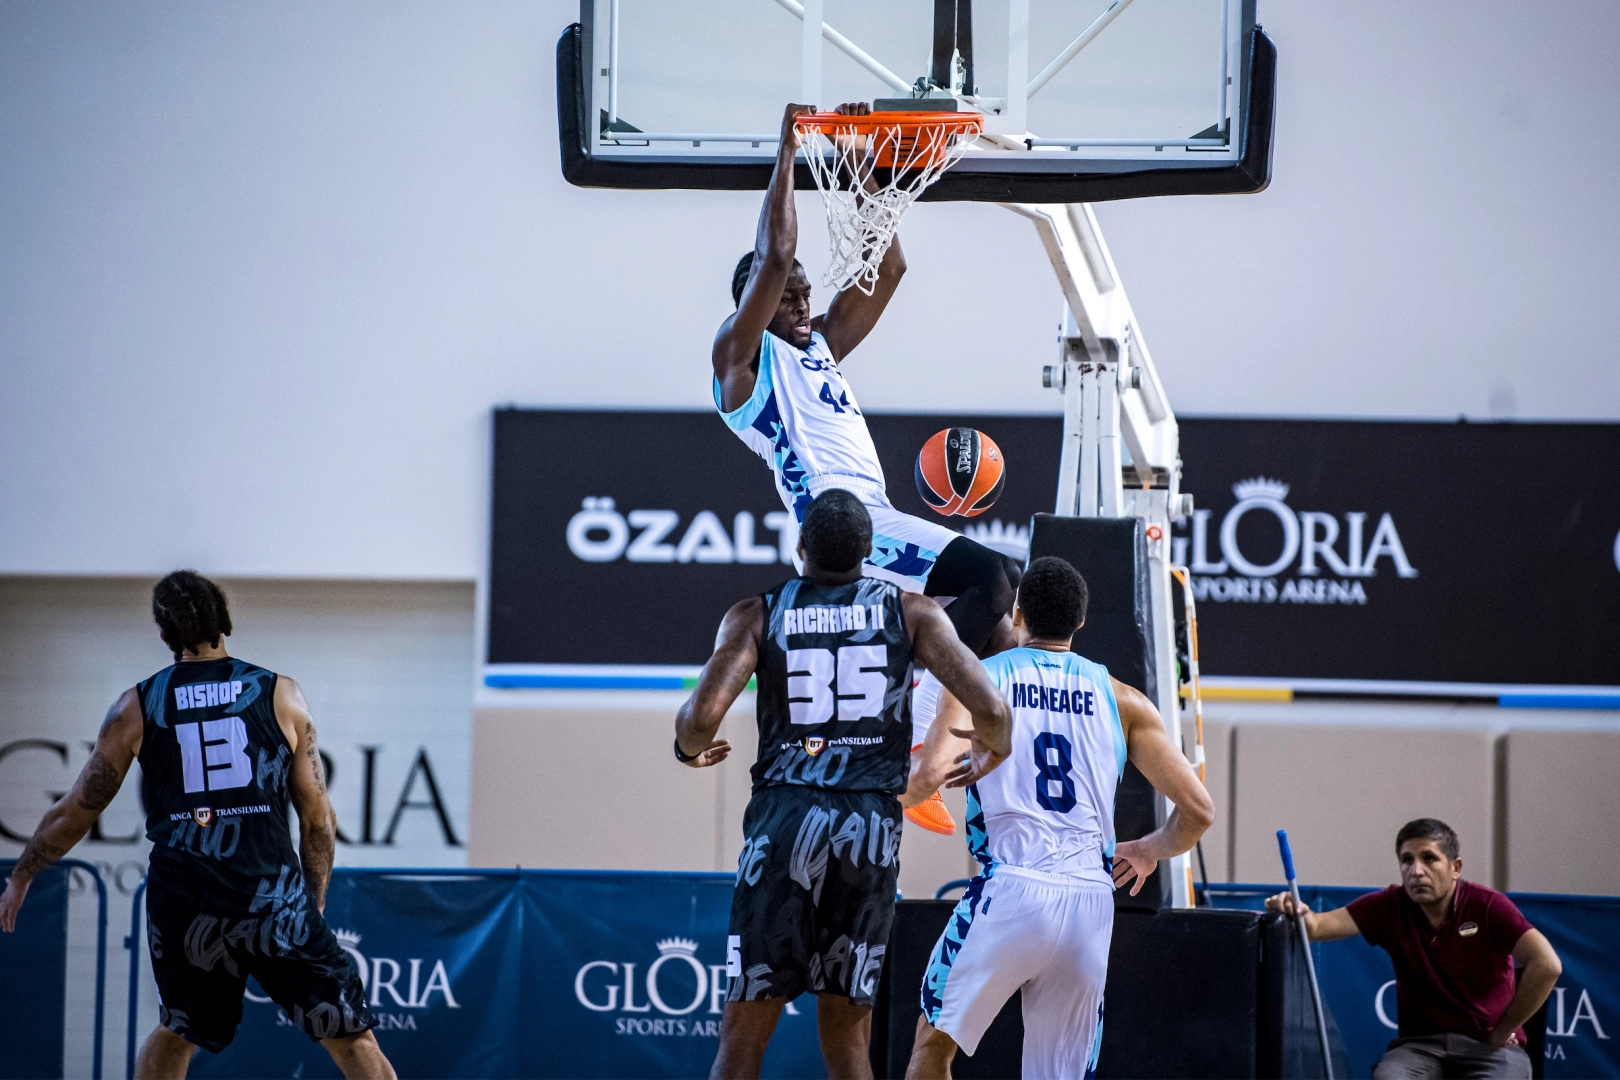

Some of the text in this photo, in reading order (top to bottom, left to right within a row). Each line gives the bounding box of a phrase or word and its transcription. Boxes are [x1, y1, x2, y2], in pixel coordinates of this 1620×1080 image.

[1190, 577, 1366, 605] PORTS ARENA
[784, 604, 885, 636] RICHARD II
[174, 680, 243, 711] BISHOP
[786, 644, 888, 725] 35
[1012, 682, 1094, 717] MCNEACE
[174, 716, 253, 794] 13
[1033, 731, 1077, 814] 8
[215, 804, 271, 817] TRANSILVANIA
[615, 1017, 688, 1035] SPORTS
